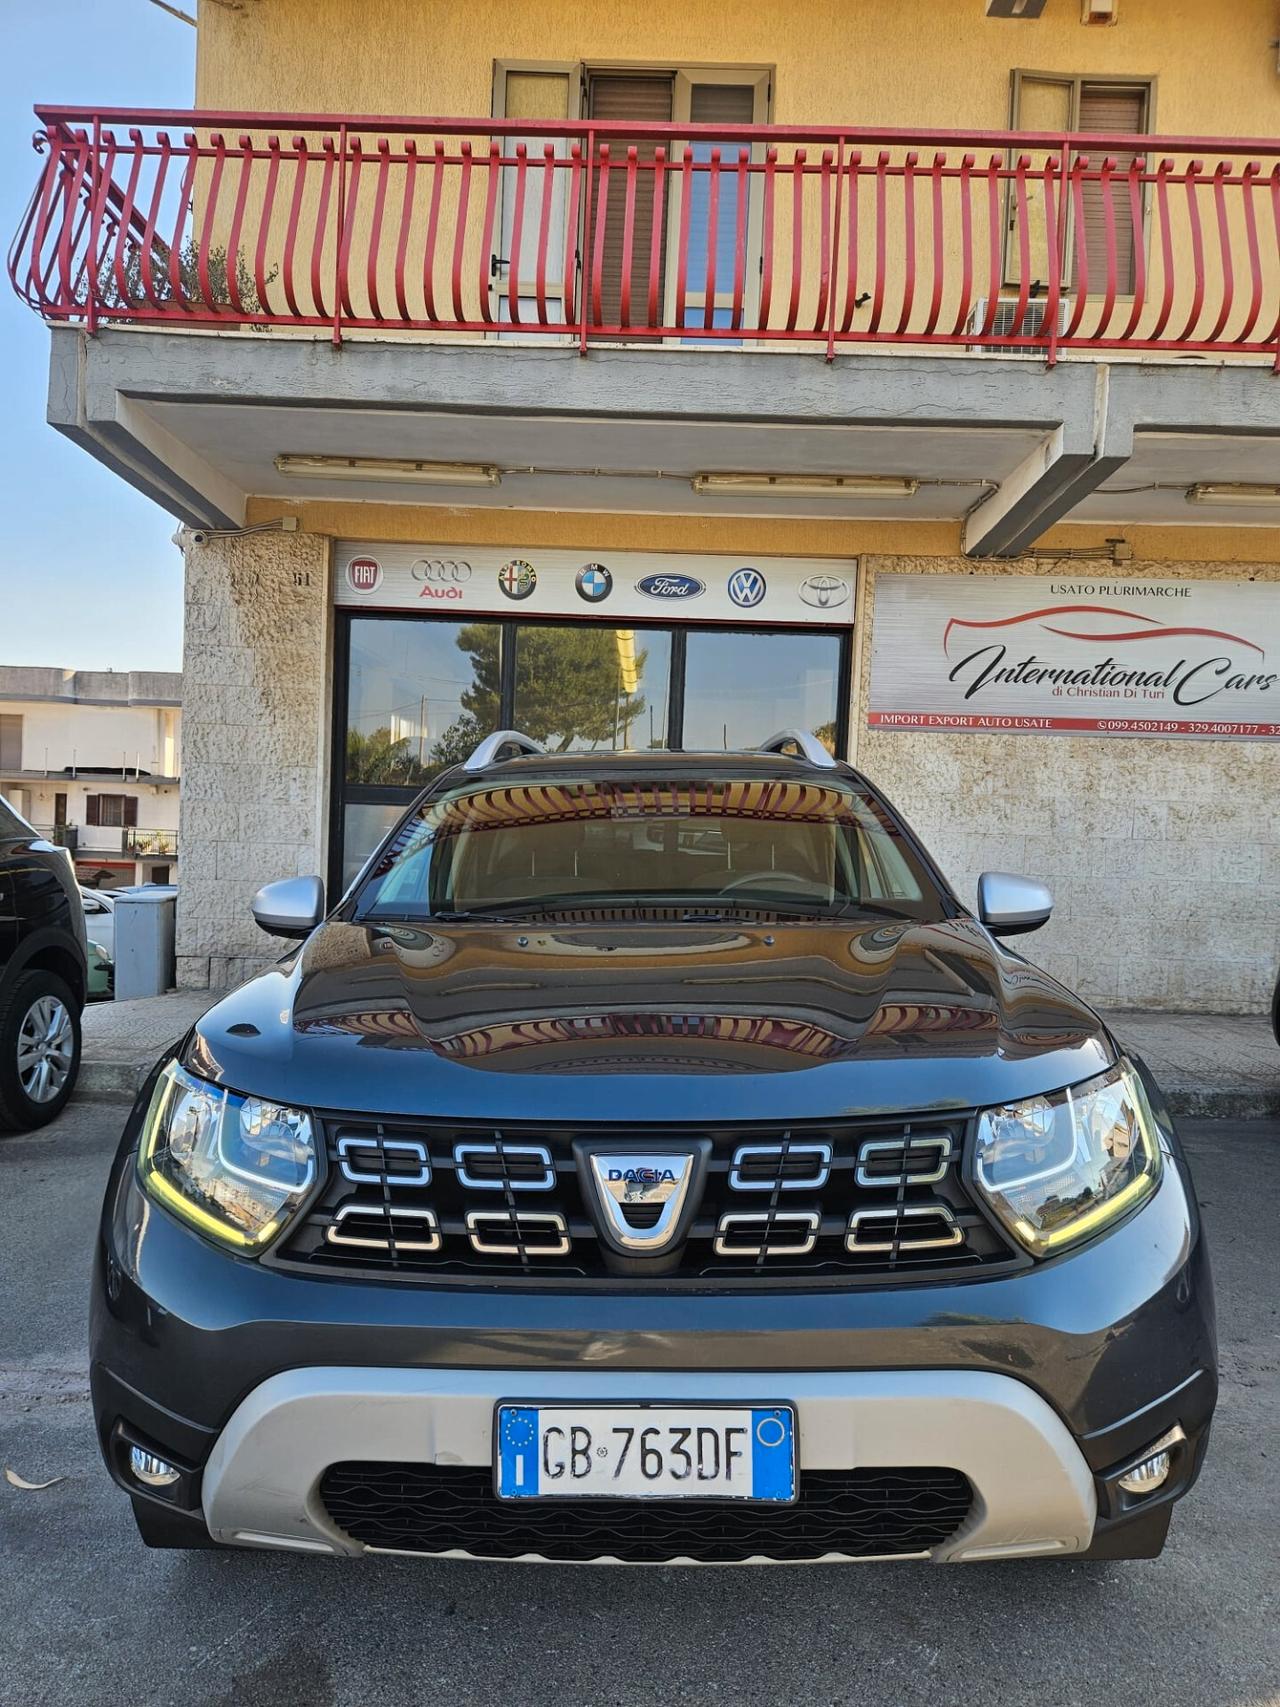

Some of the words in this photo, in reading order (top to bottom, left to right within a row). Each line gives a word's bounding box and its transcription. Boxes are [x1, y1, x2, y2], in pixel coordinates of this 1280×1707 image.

[354, 566, 376, 584] FIAT
[420, 585, 463, 599] Audi
[650, 577, 689, 596] Ford
[1050, 584, 1095, 595] USATO
[1099, 585, 1192, 597] PLURIMARCHE
[949, 644, 1186, 700] International
[1173, 657, 1280, 706] Cars
[1052, 686, 1063, 697] di
[1067, 686, 1120, 698] Christian
[1124, 688, 1137, 698] Di
[1141, 688, 1165, 699] Turi
[880, 714, 925, 725] IMPORT
[929, 716, 974, 726] EXPORT
[978, 717, 1012, 727] AUTO
[1015, 718, 1053, 728] USATE
[1108, 720, 1178, 732] 099.4502149
[1188, 723, 1258, 735] 329.4007177
[608, 1168, 675, 1183] DACIA
[543, 1426, 592, 1480] GB
[611, 1427, 748, 1481] 763DF
